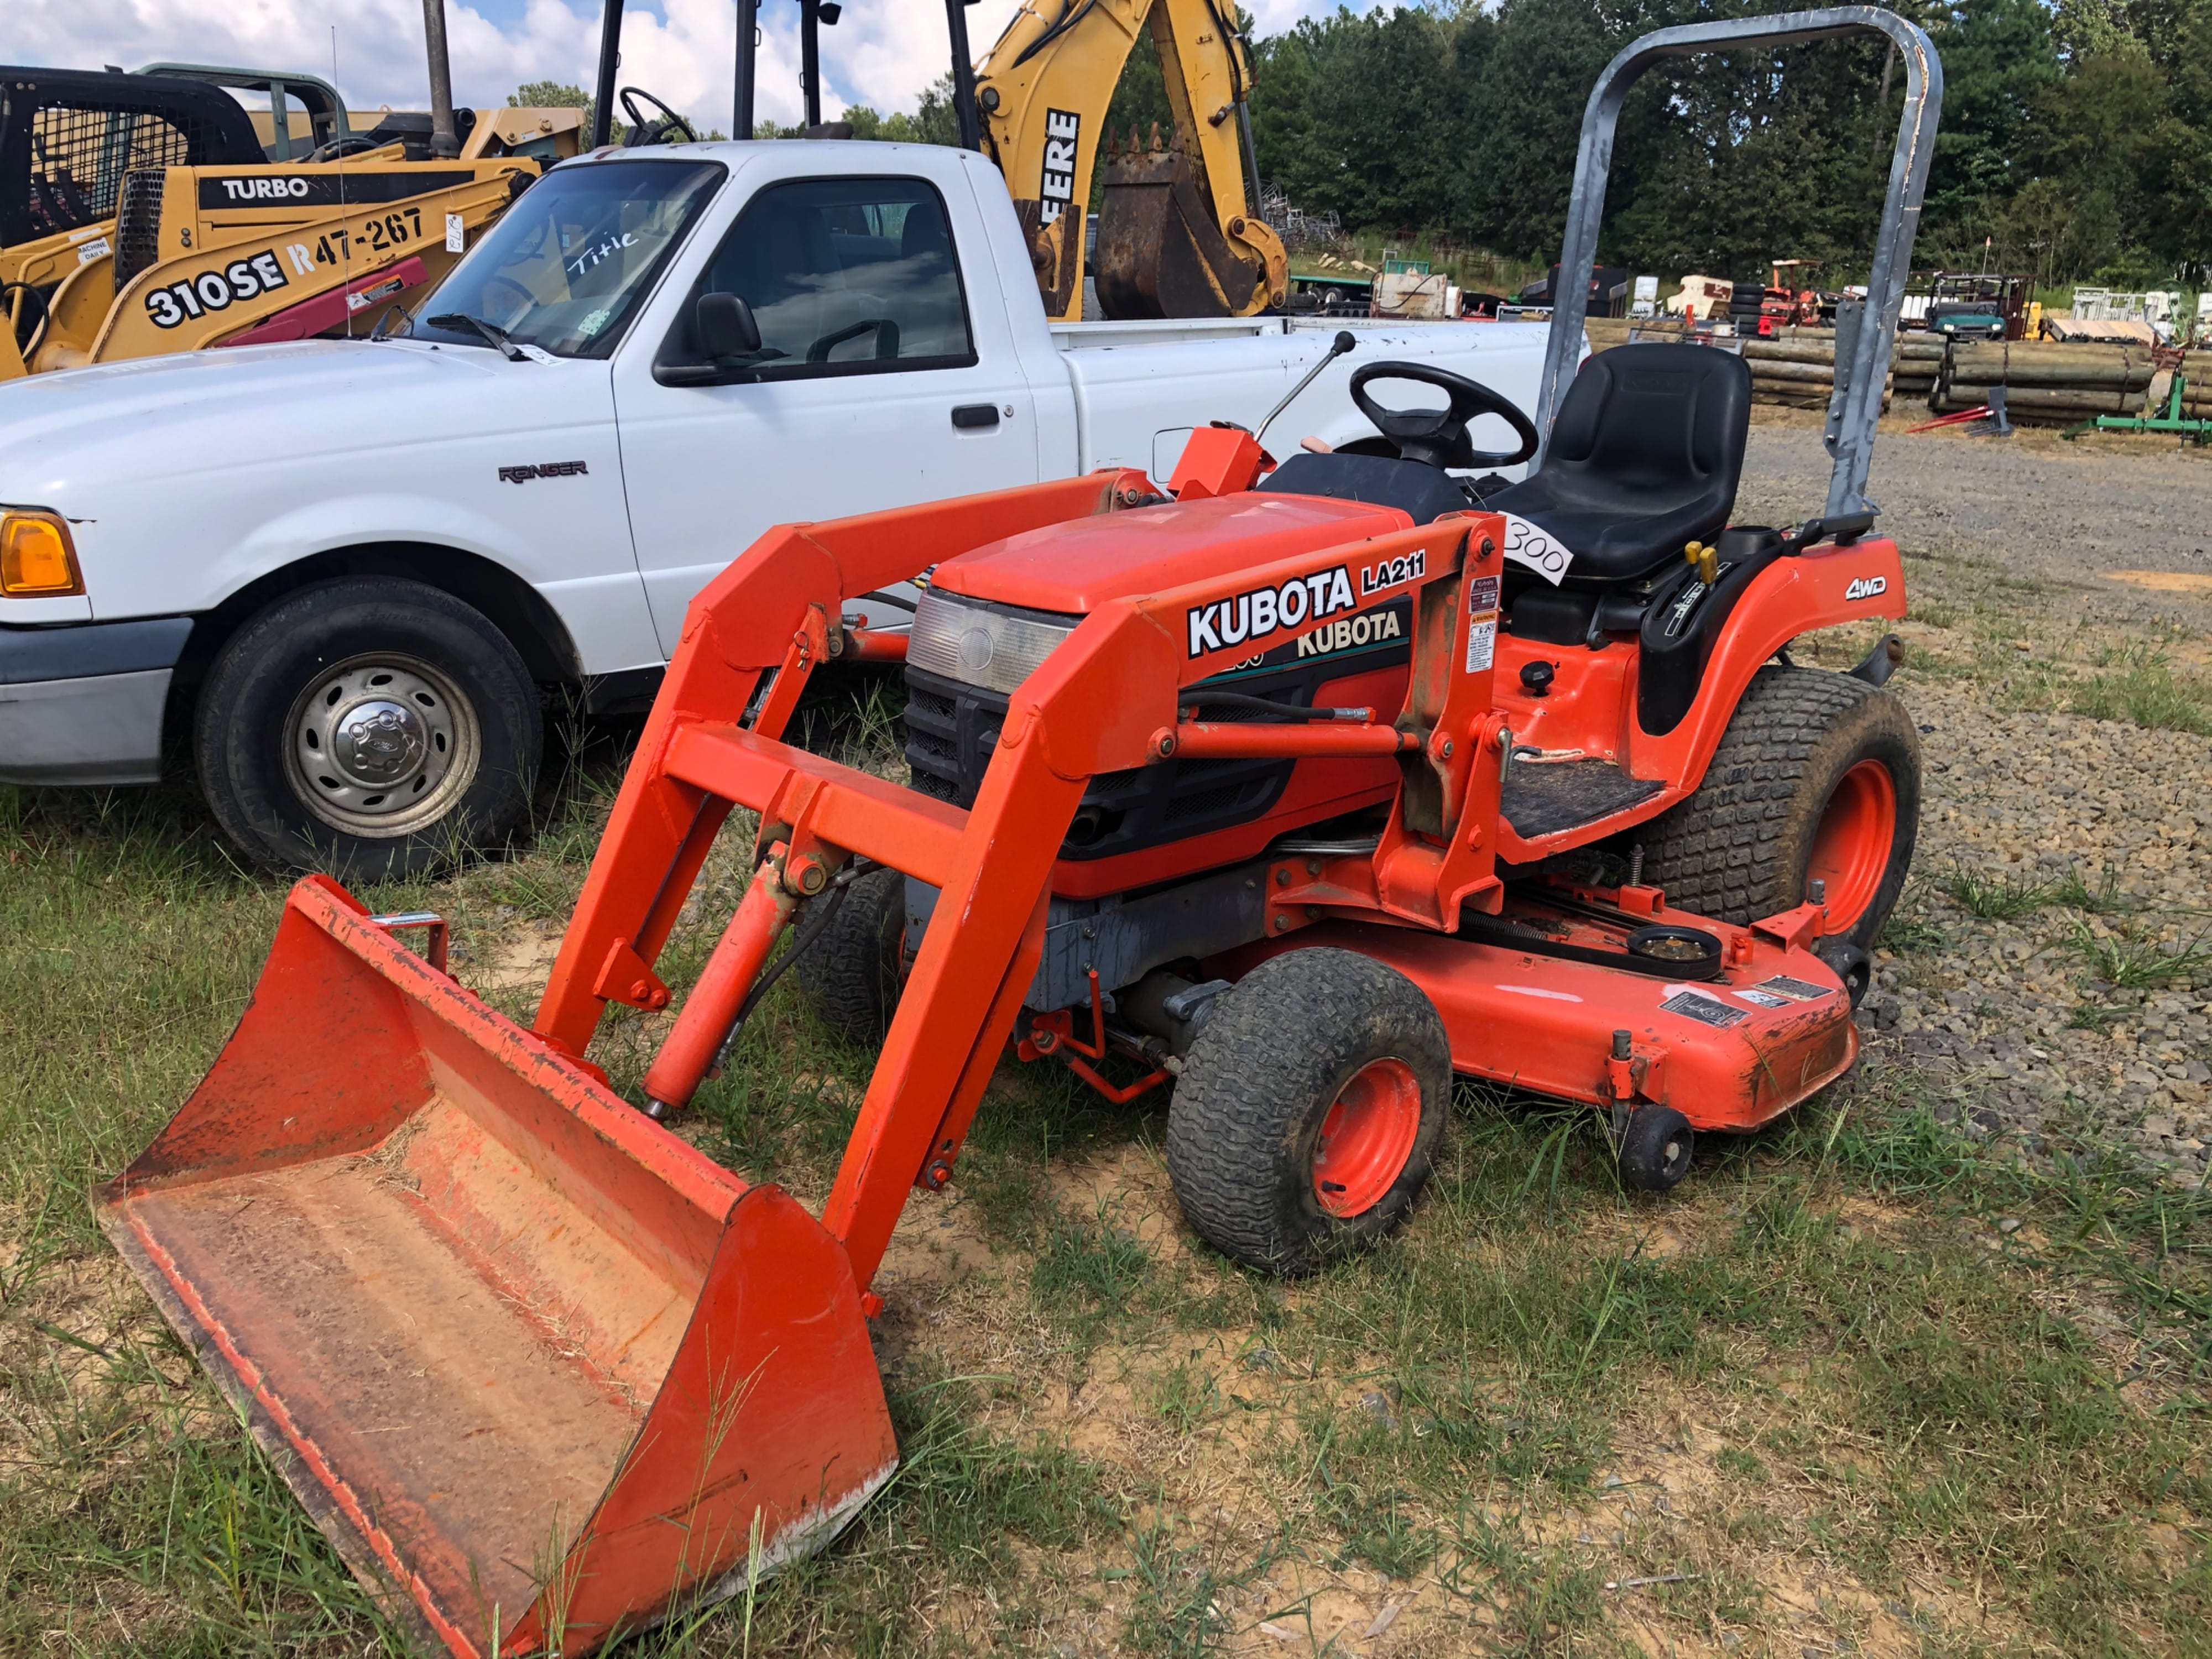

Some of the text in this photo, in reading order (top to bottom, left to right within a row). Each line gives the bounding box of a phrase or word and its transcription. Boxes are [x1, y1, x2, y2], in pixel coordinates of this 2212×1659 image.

[222, 178, 310, 200] TURBO
[1040, 112, 1078, 223] EERE
[567, 233, 639, 274] Title
[145, 249, 288, 328] 310SE
[1504, 522, 1564, 572] 300
[1189, 550, 1426, 657] KUBOTA LA211
[1845, 576, 1887, 601] 4WD
[1298, 611, 1400, 658] KUBOTA
